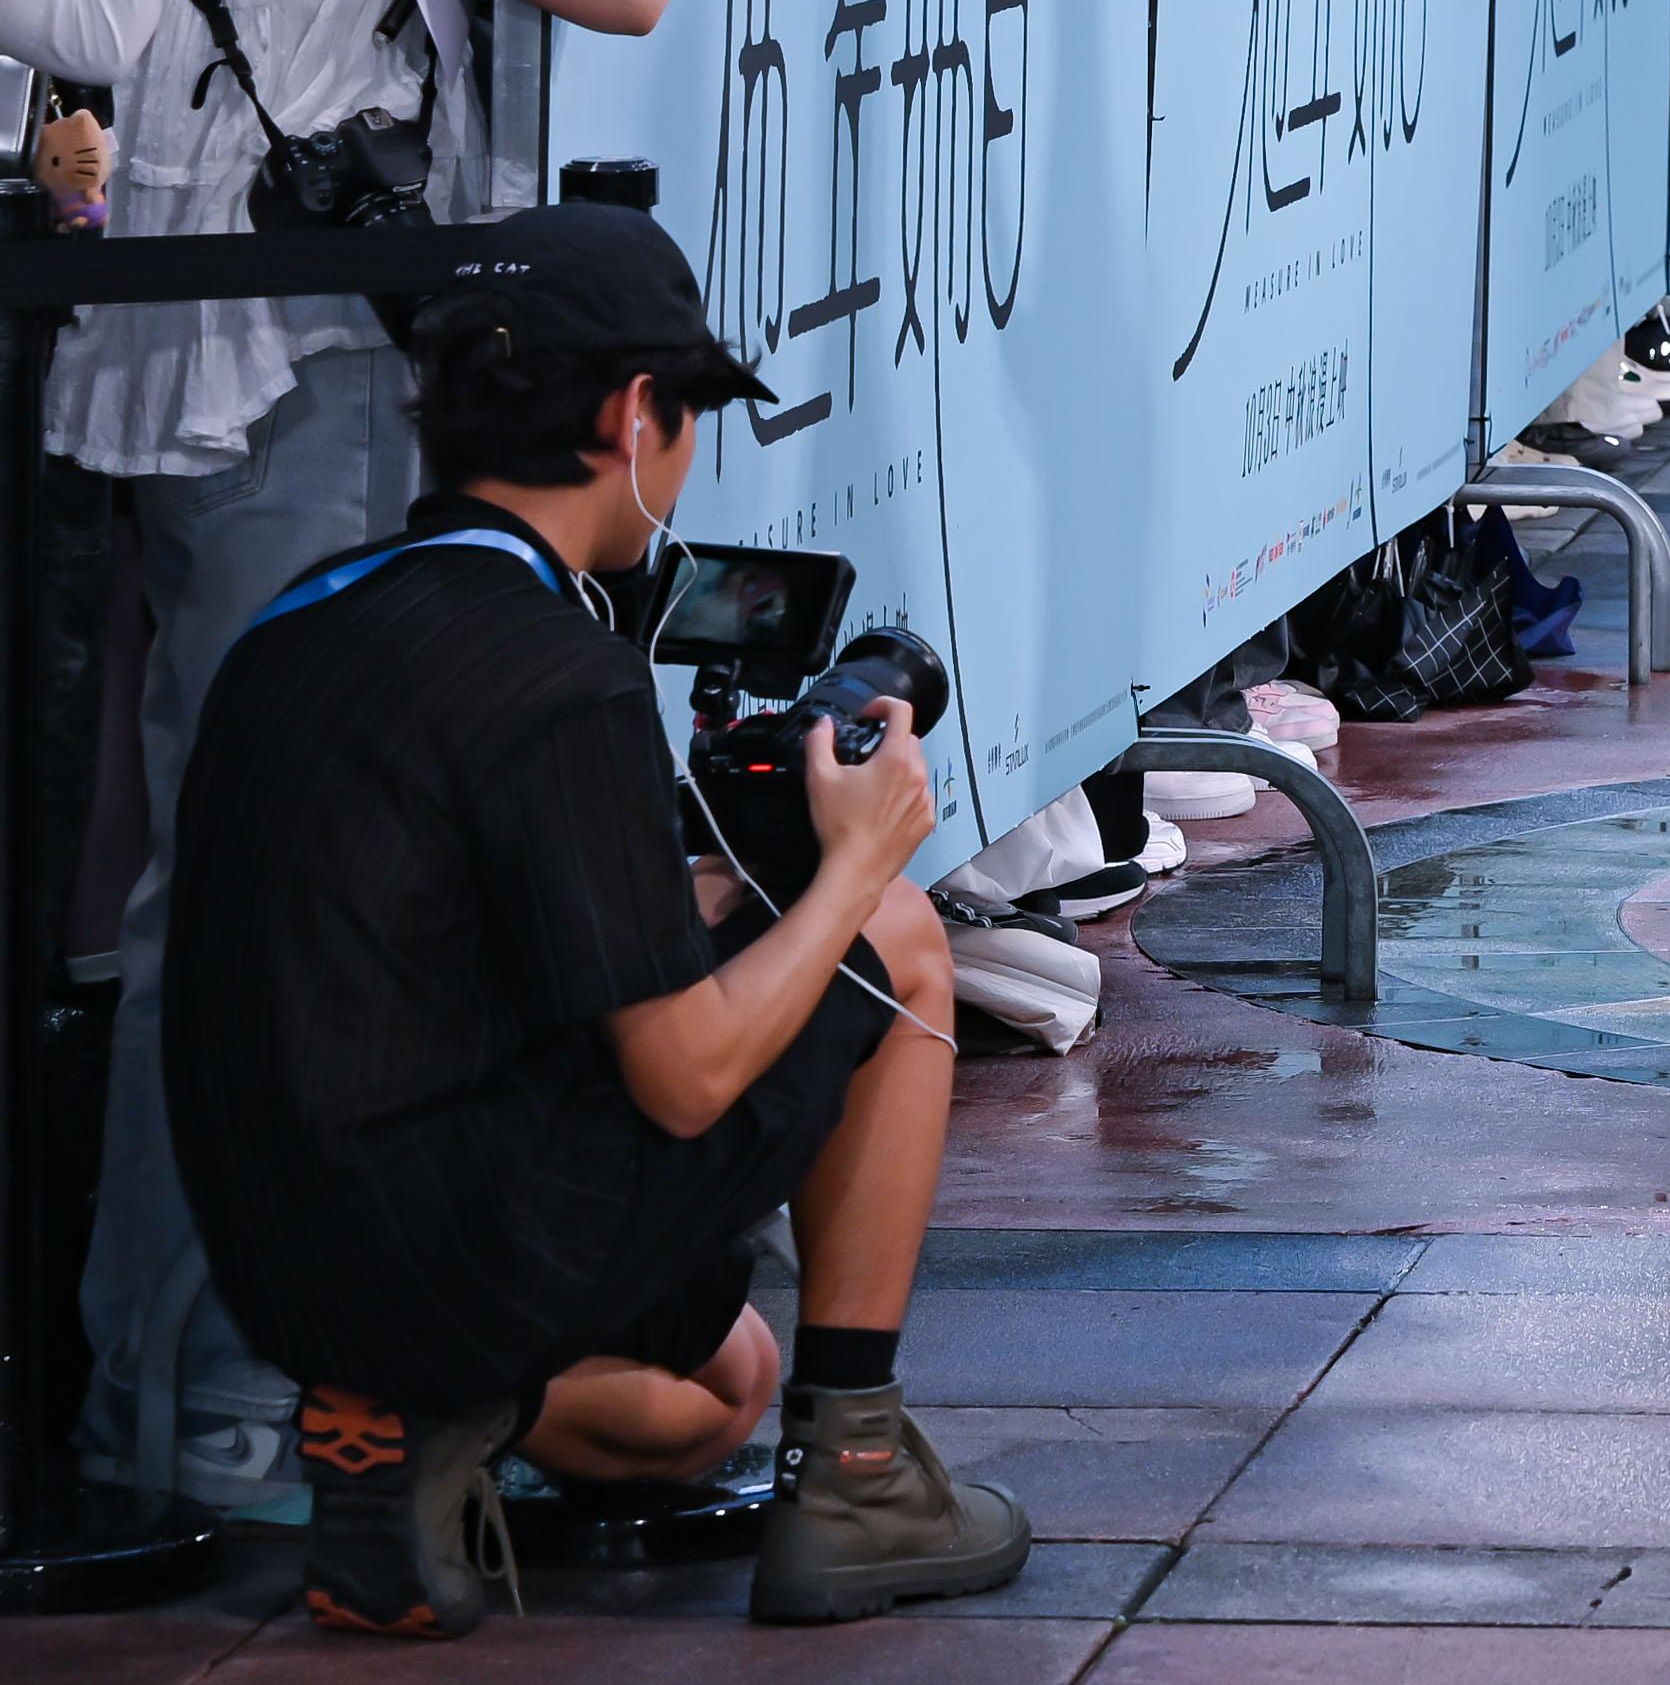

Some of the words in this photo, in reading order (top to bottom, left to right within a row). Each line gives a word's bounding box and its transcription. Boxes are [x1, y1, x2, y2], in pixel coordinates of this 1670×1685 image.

[494, 262, 531, 274] CAT
[1244, 259, 1300, 314] MEASURE
[1308, 250, 1321, 281] IN
[1331, 229, 1363, 269] LOVE
[834, 484, 853, 527] IN
[874, 450, 922, 506] LOVE
